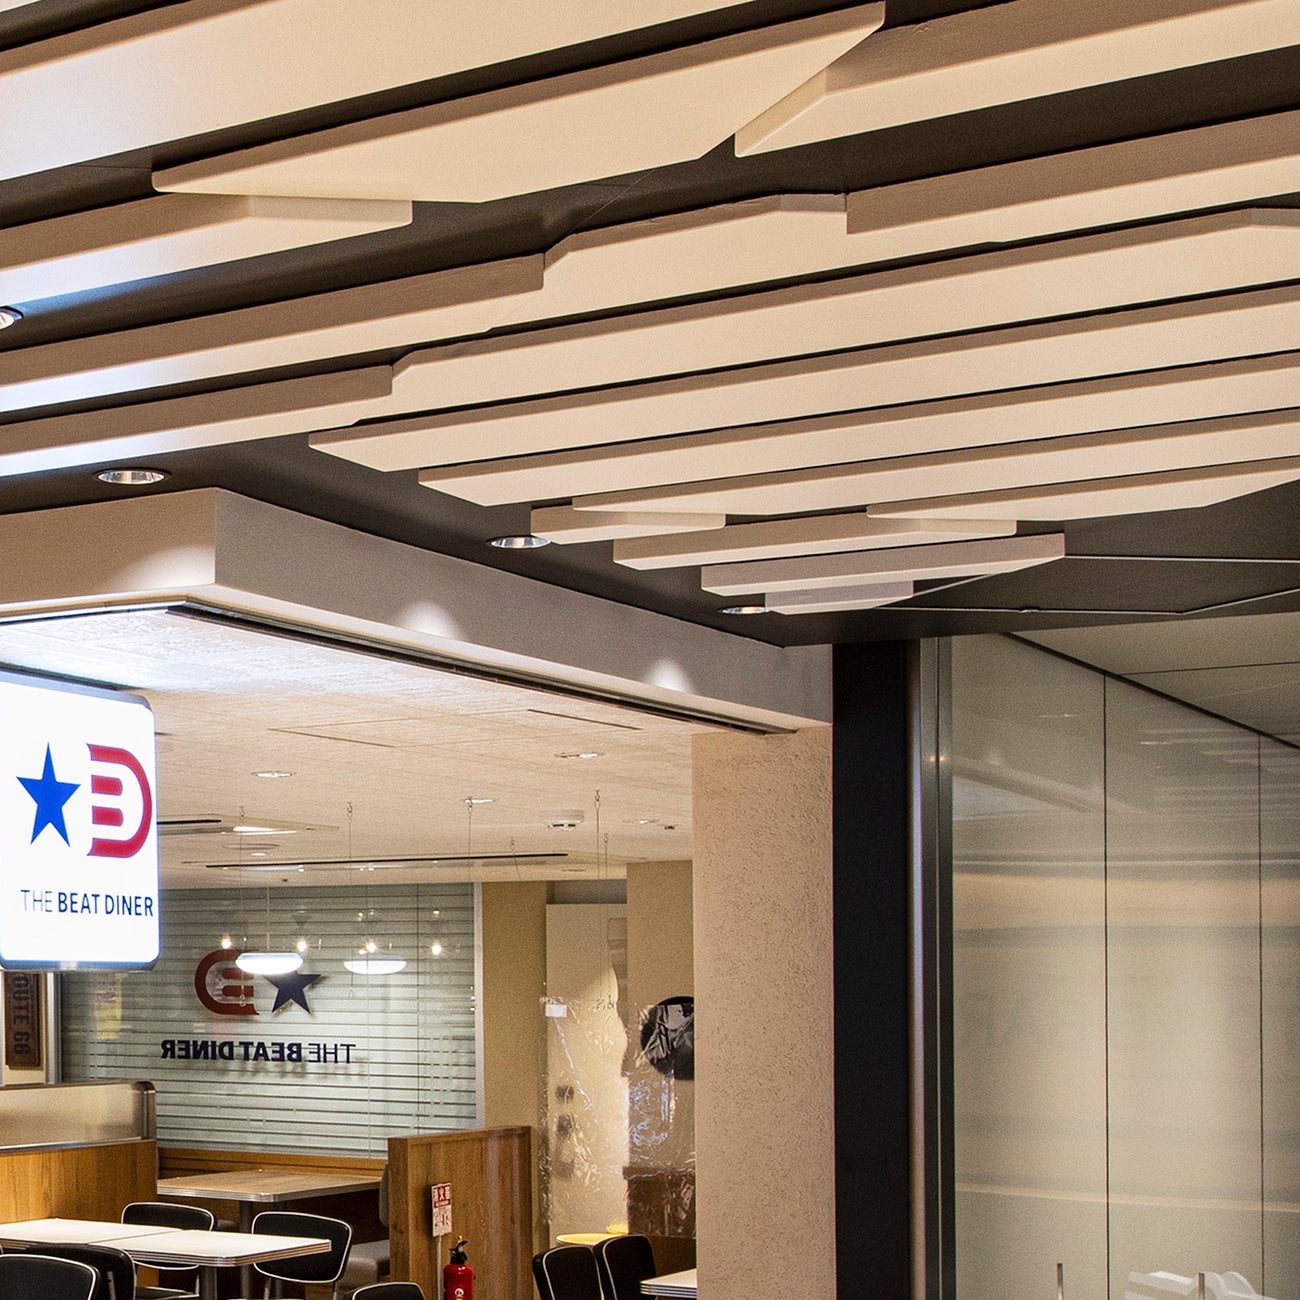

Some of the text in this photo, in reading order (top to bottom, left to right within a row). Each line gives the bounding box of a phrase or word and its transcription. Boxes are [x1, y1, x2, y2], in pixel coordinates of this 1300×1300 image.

[20, 889, 153, 916] THE BEAT DINER
